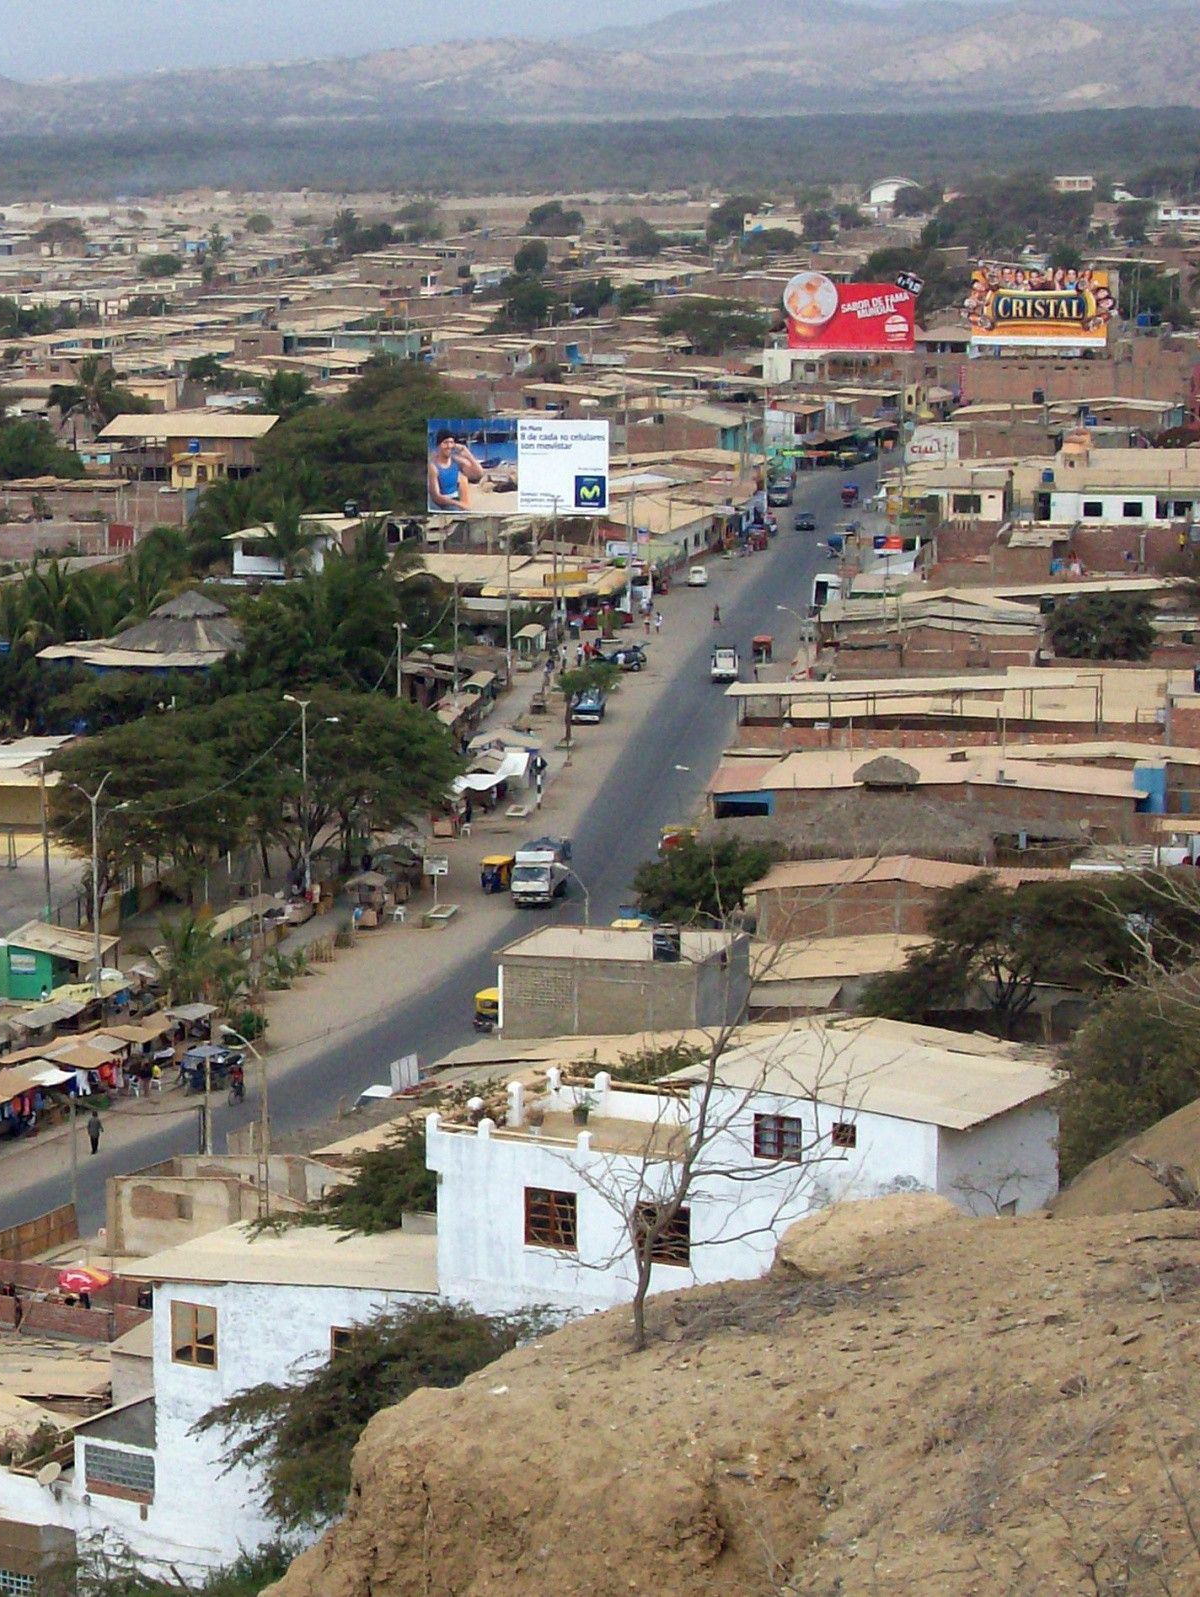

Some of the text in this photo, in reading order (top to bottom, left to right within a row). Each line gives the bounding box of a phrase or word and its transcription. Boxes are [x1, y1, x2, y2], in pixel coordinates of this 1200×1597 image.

[841, 292, 910, 314] SABOR DE FAMA
[857, 303, 897, 319] MUNDIAL
[998, 297, 1083, 318] CRISTAL
